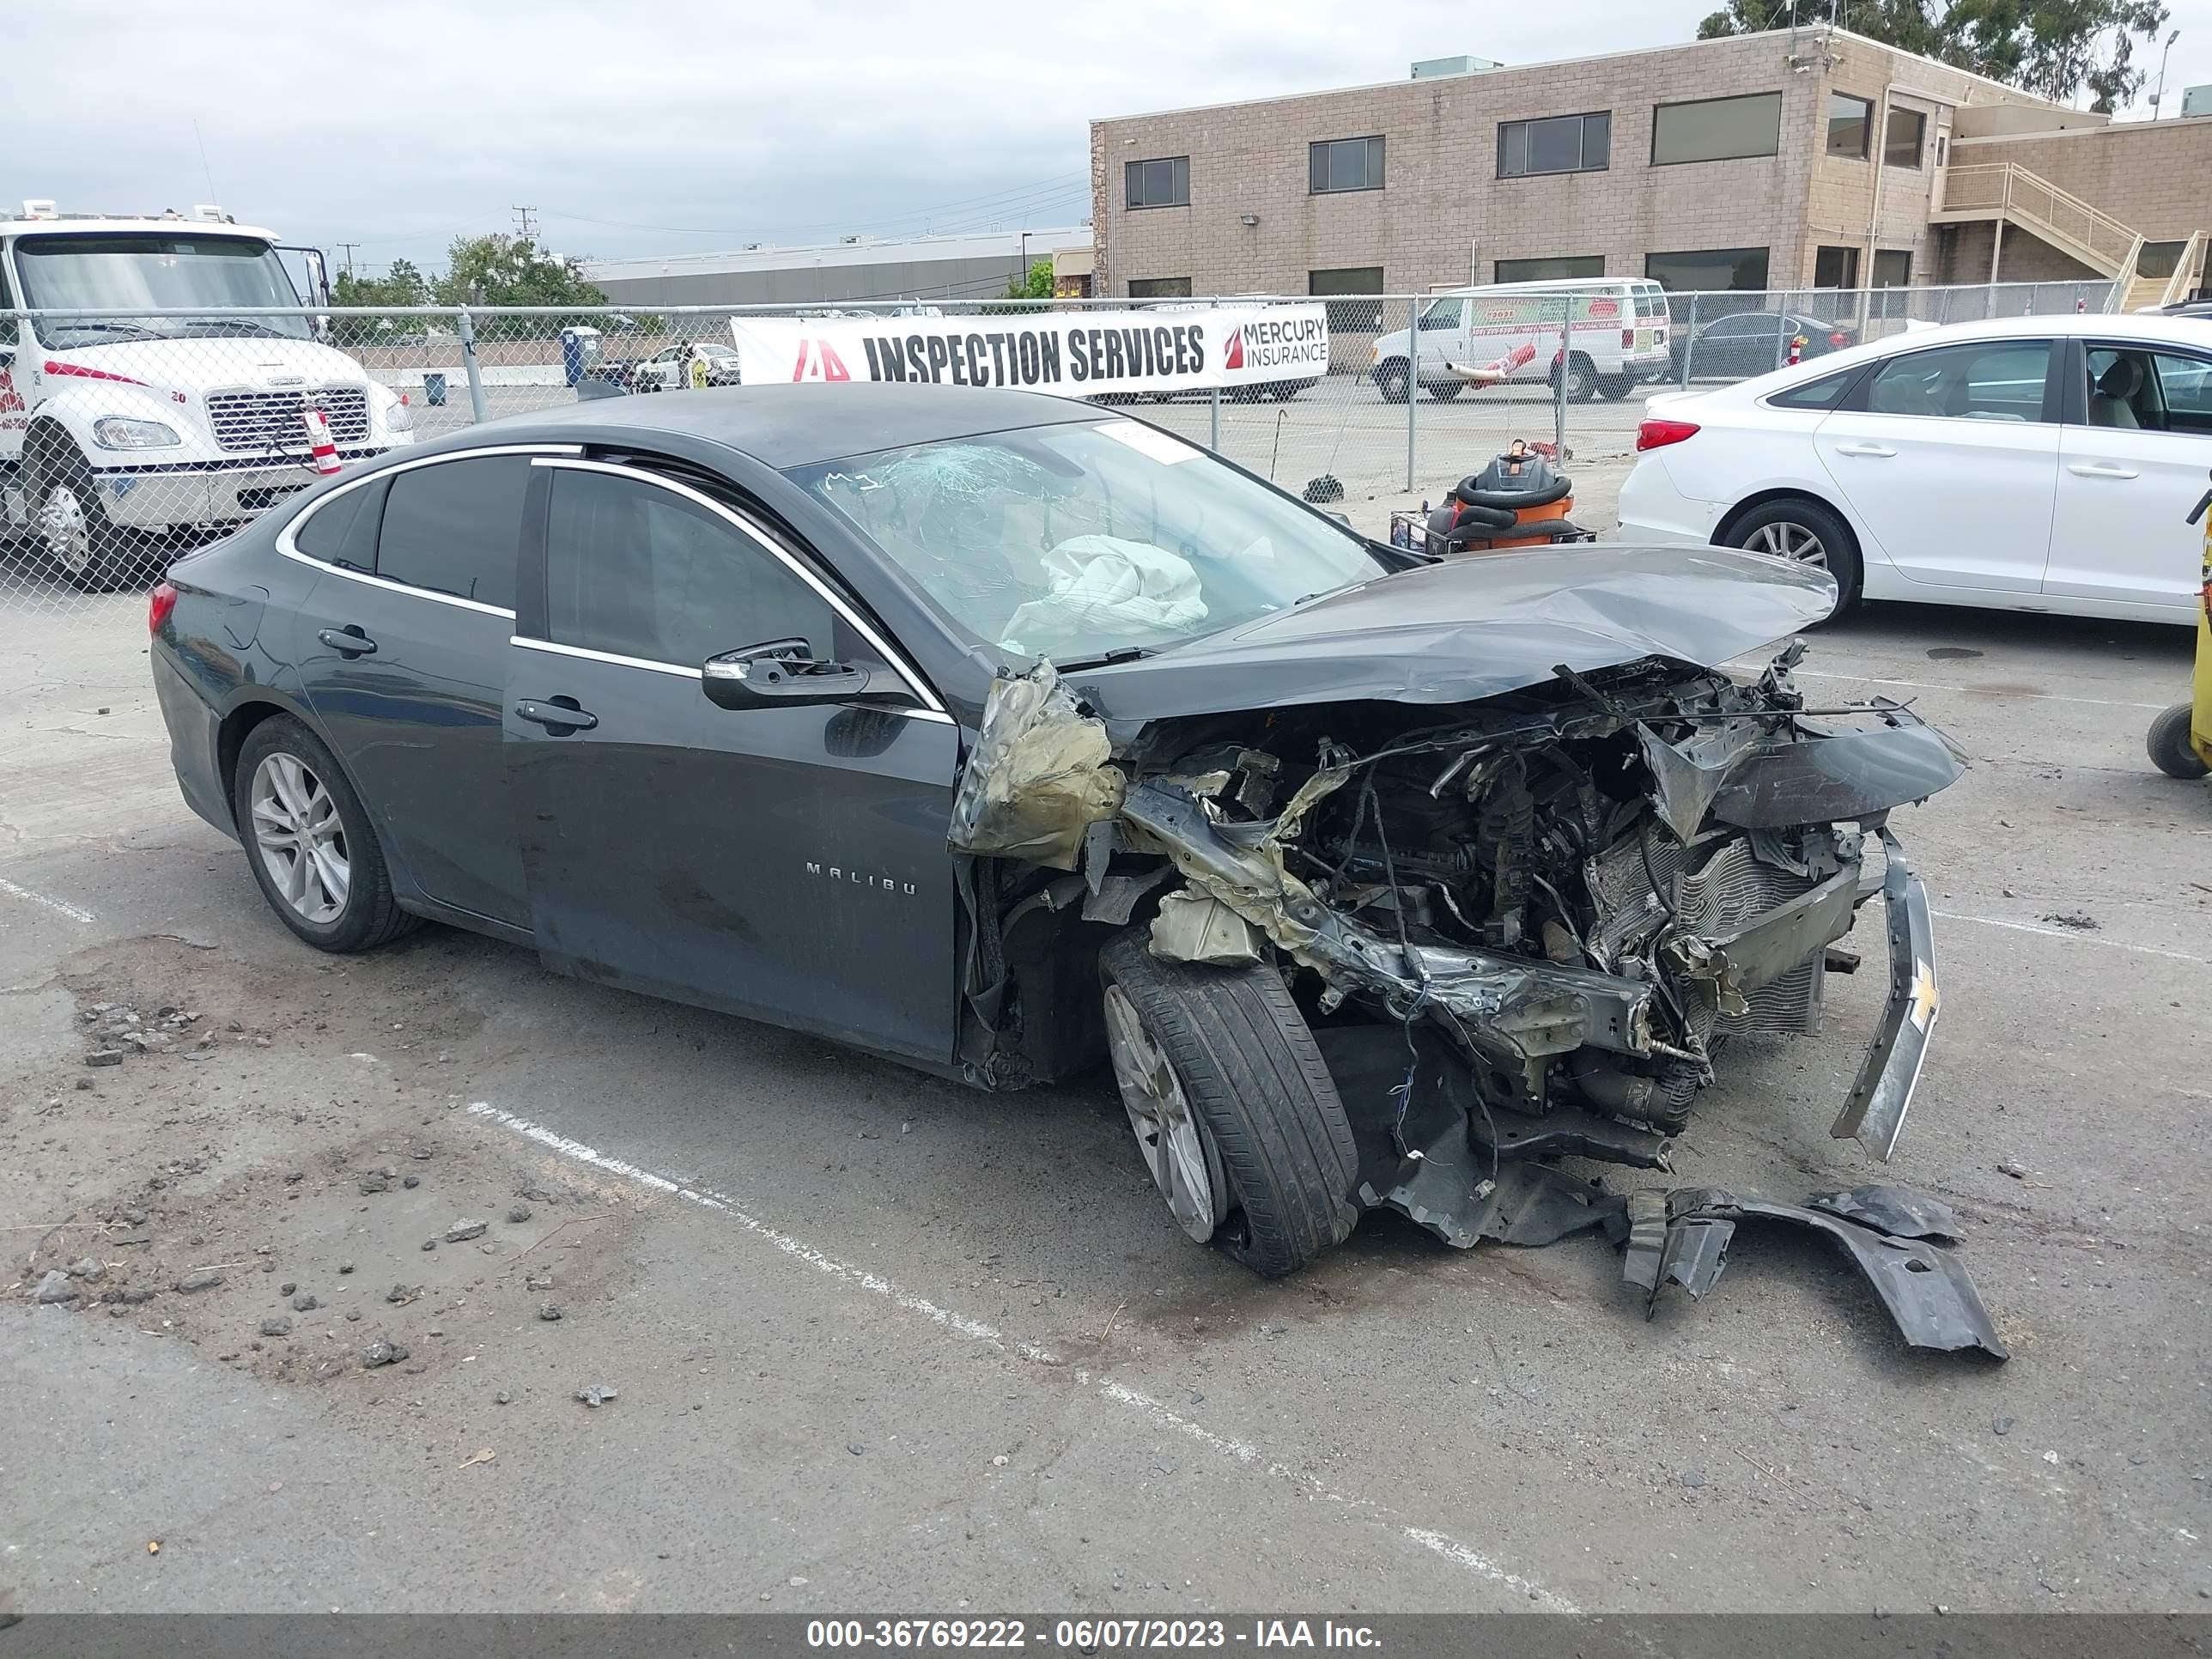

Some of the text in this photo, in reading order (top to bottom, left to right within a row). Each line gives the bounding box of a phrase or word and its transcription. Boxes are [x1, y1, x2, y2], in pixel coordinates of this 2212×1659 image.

[1243, 318, 1325, 345] MERCURY
[863, 331, 1061, 387] INSPECTION
[1068, 325, 1204, 382] SERVICES
[1246, 342, 1328, 368] INSURANCE
[171, 391, 186, 404] 20
[805, 861, 916, 896] MALIBU
